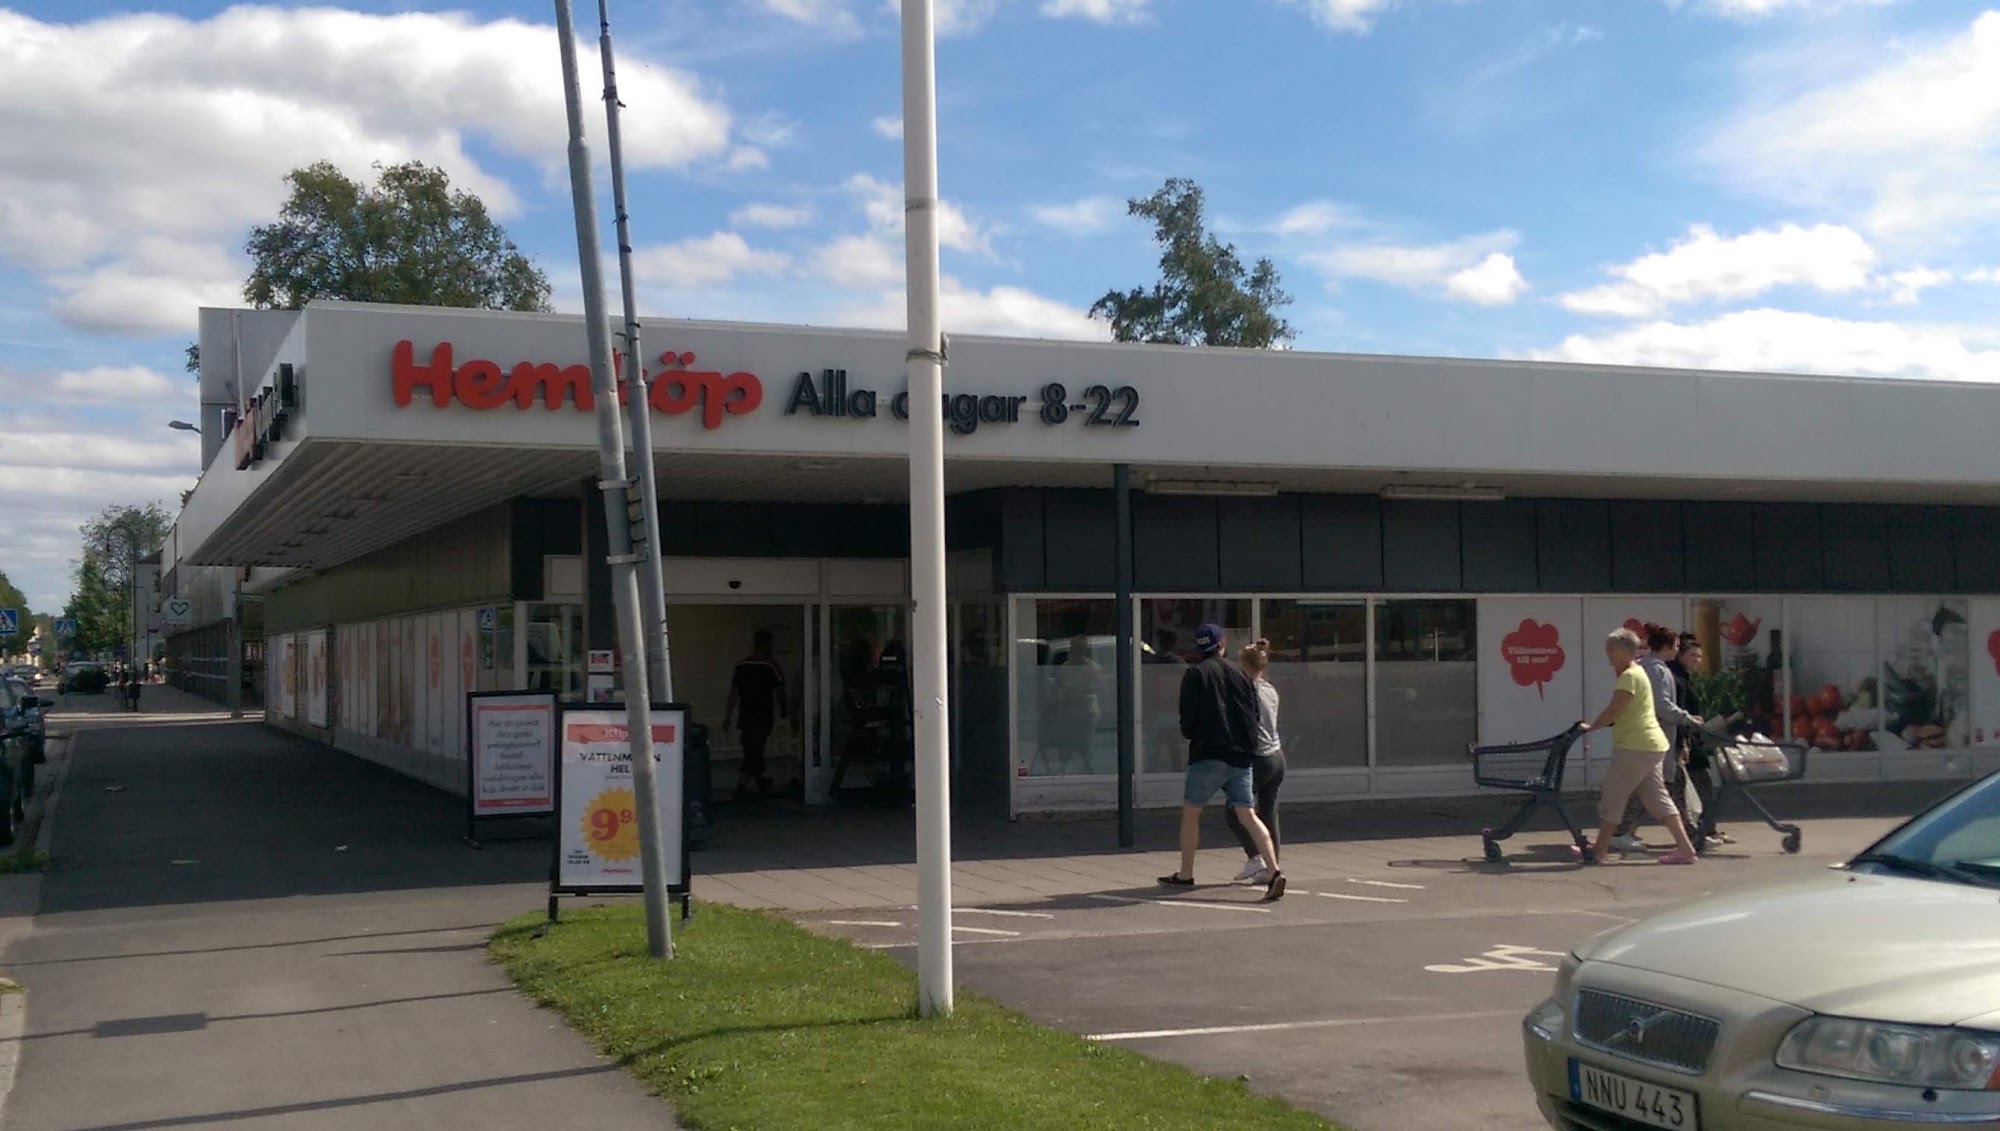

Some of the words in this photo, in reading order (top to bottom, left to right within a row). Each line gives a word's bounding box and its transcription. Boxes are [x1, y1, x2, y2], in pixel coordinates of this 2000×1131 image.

[785, 368, 876, 417] Alla
[892, 391, 1026, 435] gar
[1039, 382, 1140, 427] 8-22
[579, 752, 662, 762] VATTENMN
[610, 764, 631, 774] HEL
[1586, 1069, 1627, 1111] NNU
[1635, 1086, 1684, 1127] 443
